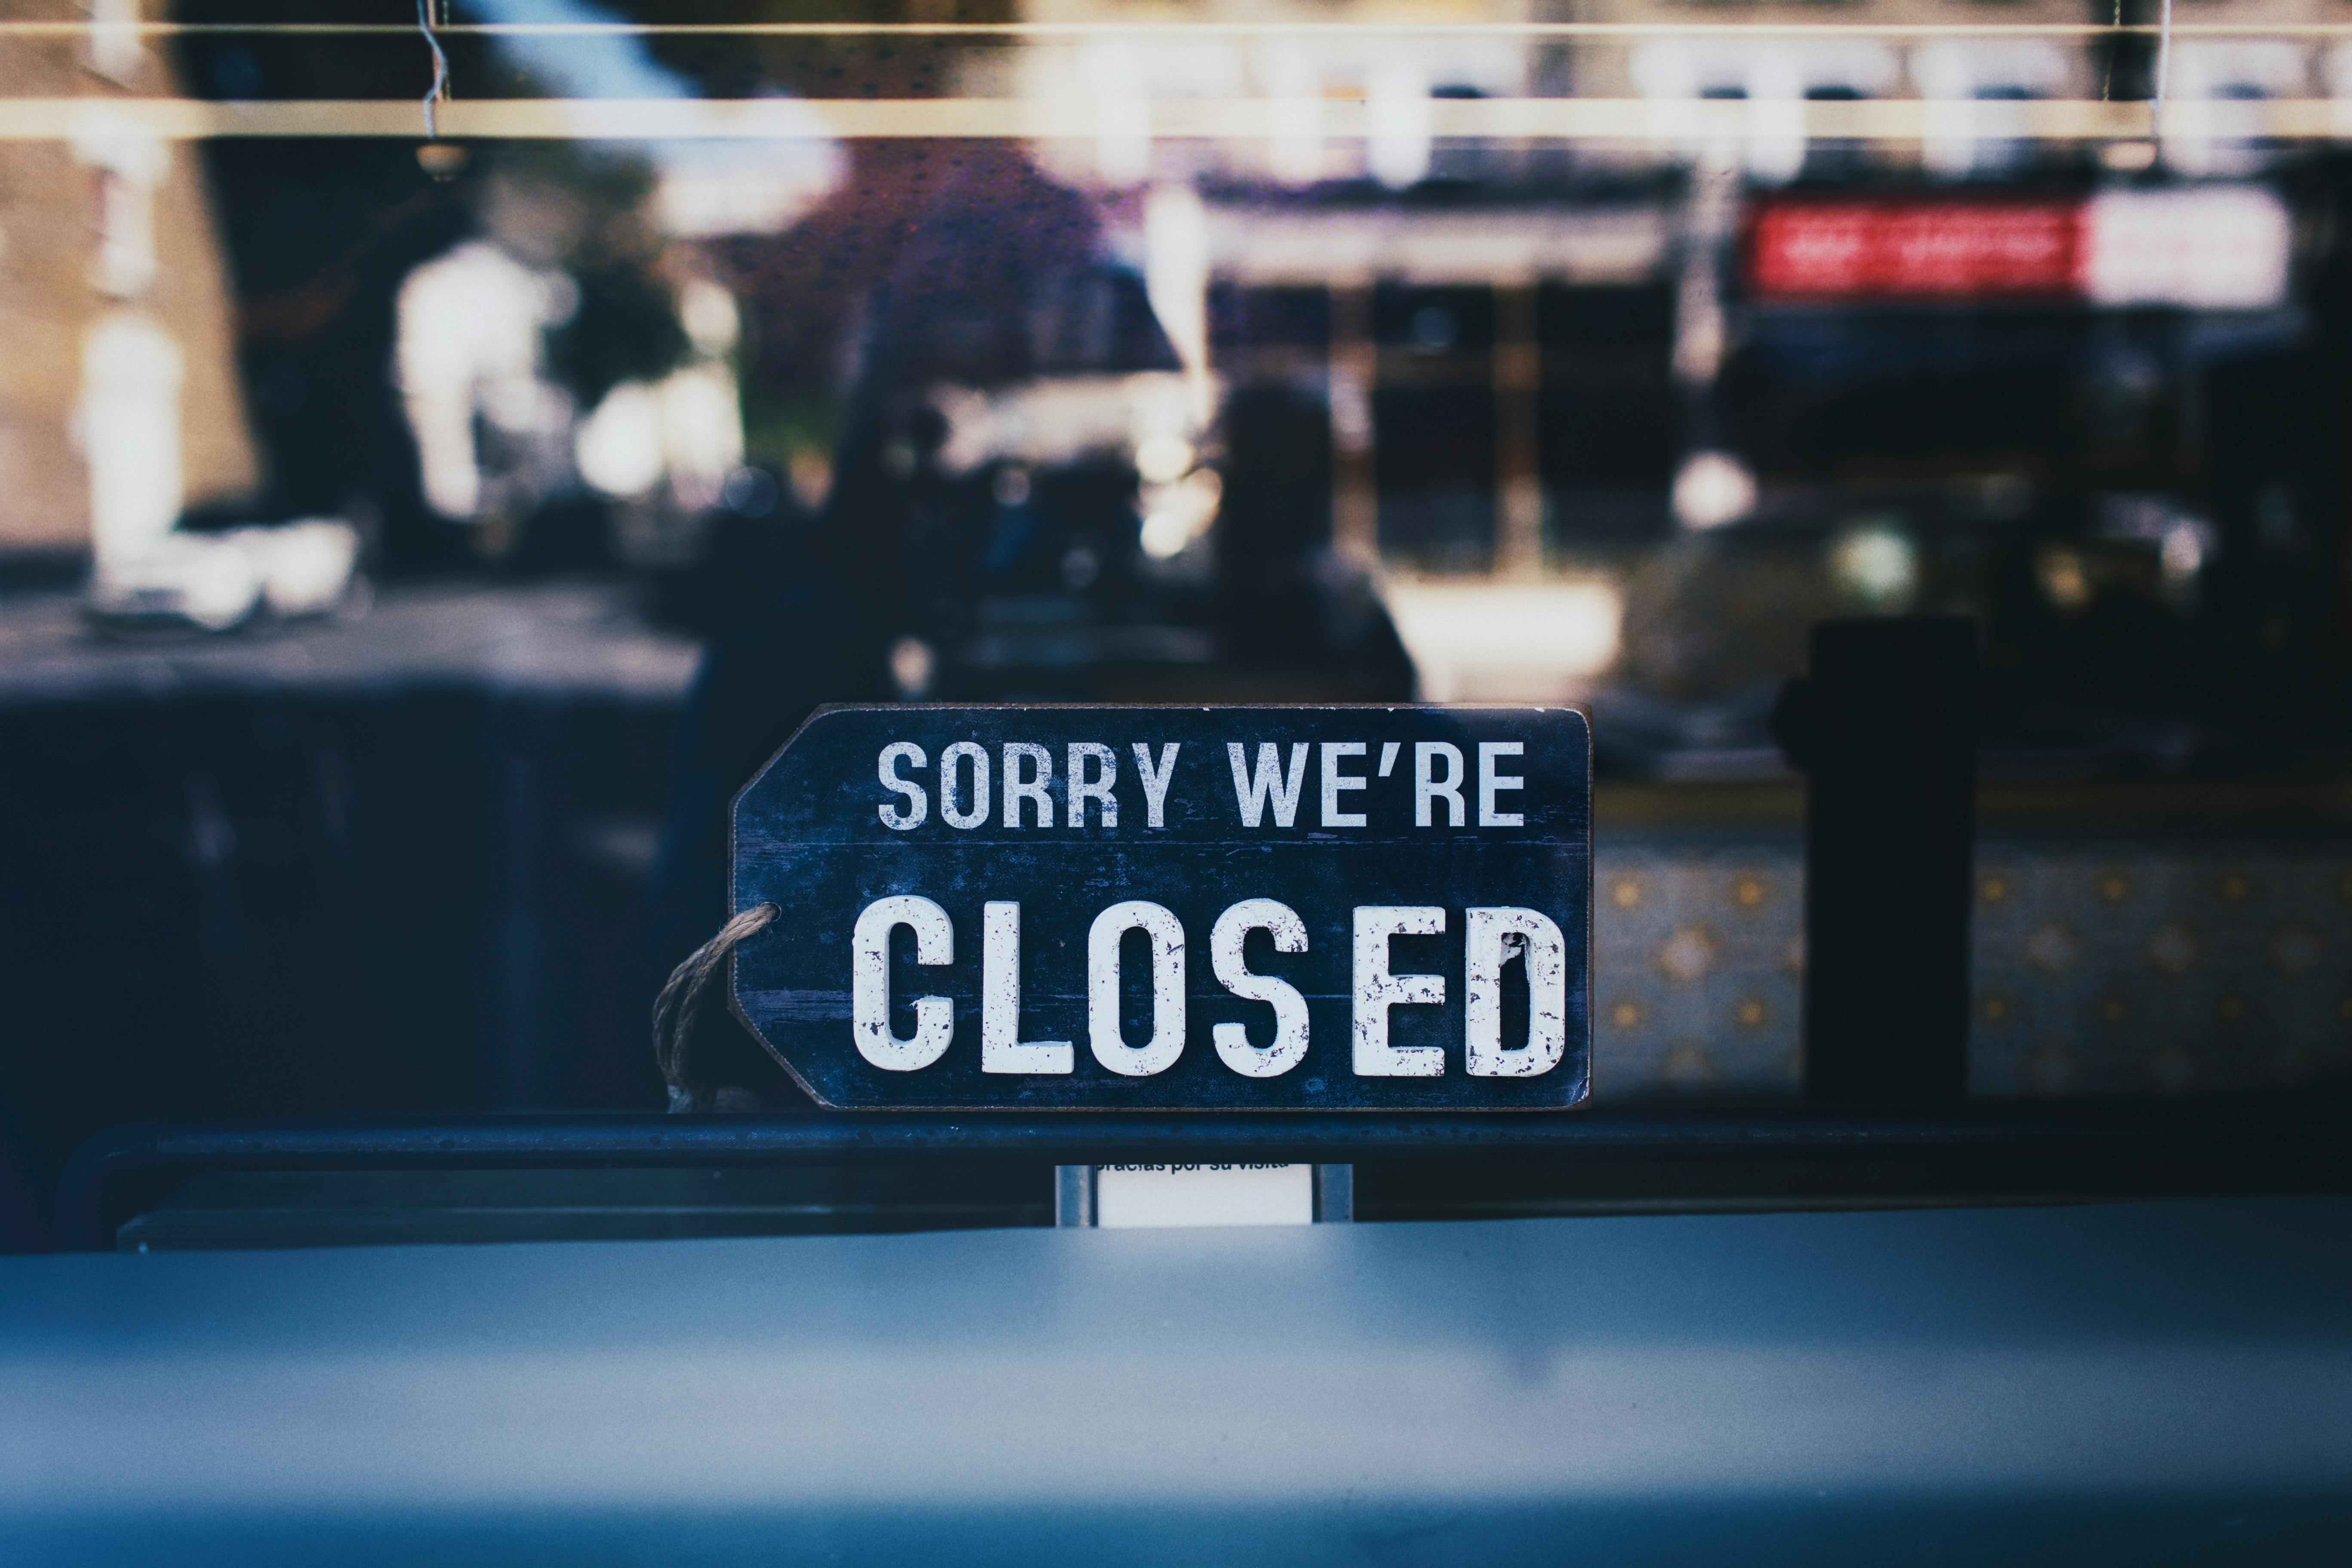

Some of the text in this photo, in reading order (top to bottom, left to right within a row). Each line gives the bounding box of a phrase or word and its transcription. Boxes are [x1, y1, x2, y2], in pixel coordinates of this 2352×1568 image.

[878, 741, 1525, 831] SORRY WE'RE
[851, 894, 1566, 1078] CLOSED
